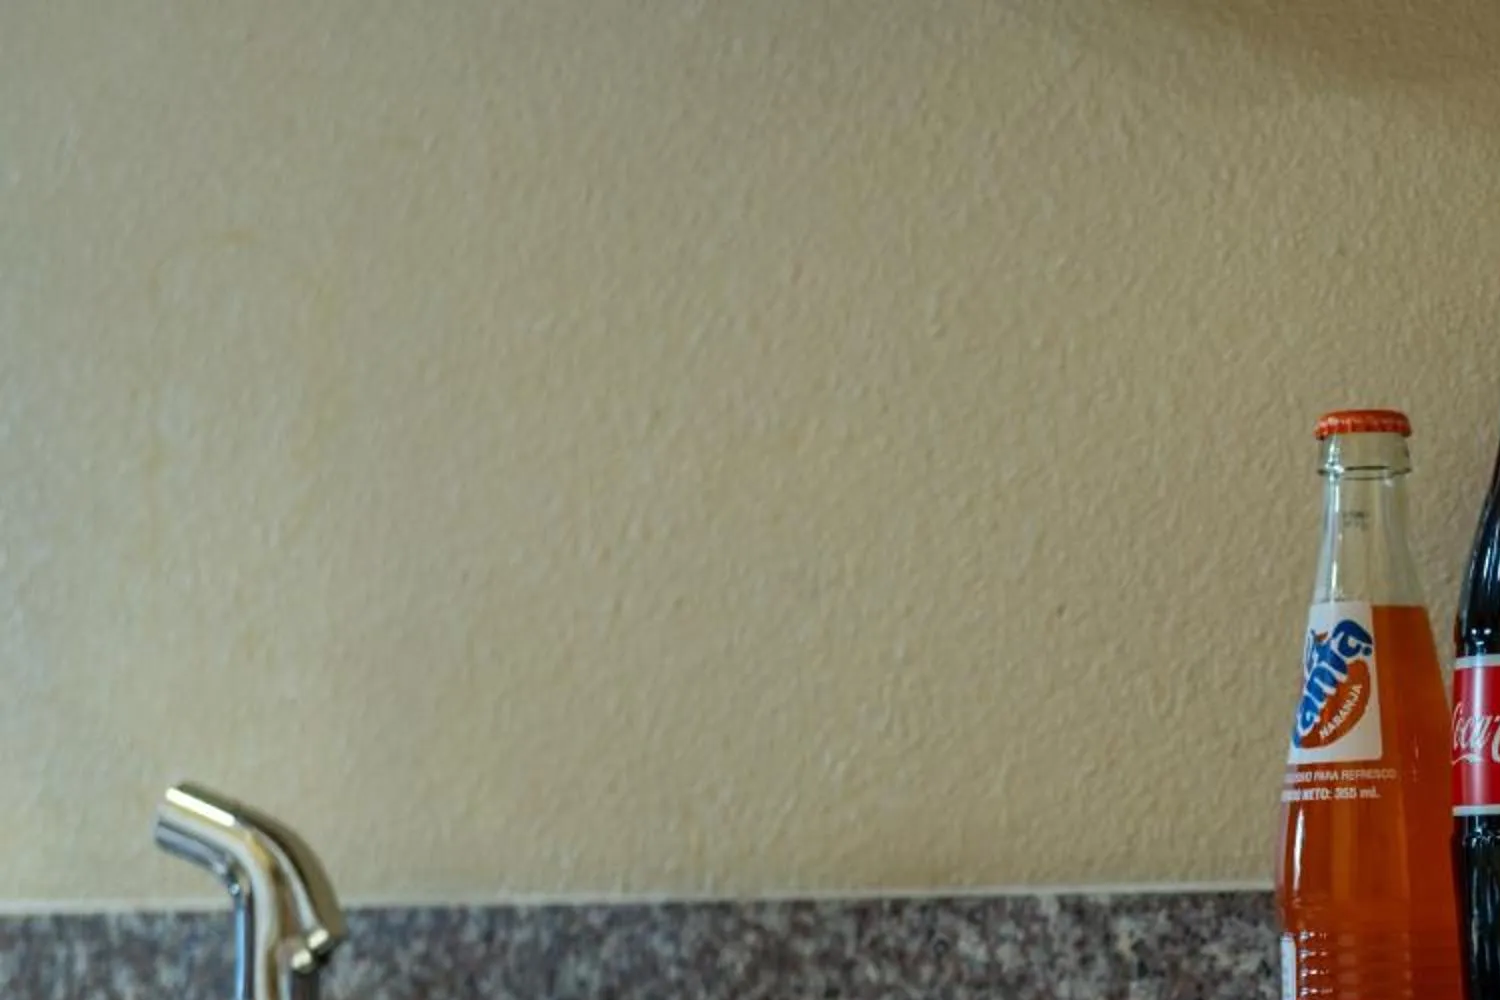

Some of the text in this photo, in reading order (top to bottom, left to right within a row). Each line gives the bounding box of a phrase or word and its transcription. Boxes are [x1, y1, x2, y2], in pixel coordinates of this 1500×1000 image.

[1291, 619, 1373, 748] anta
[1319, 684, 1362, 739] NARANJA
[1341, 768, 1397, 780] REFRESCO
